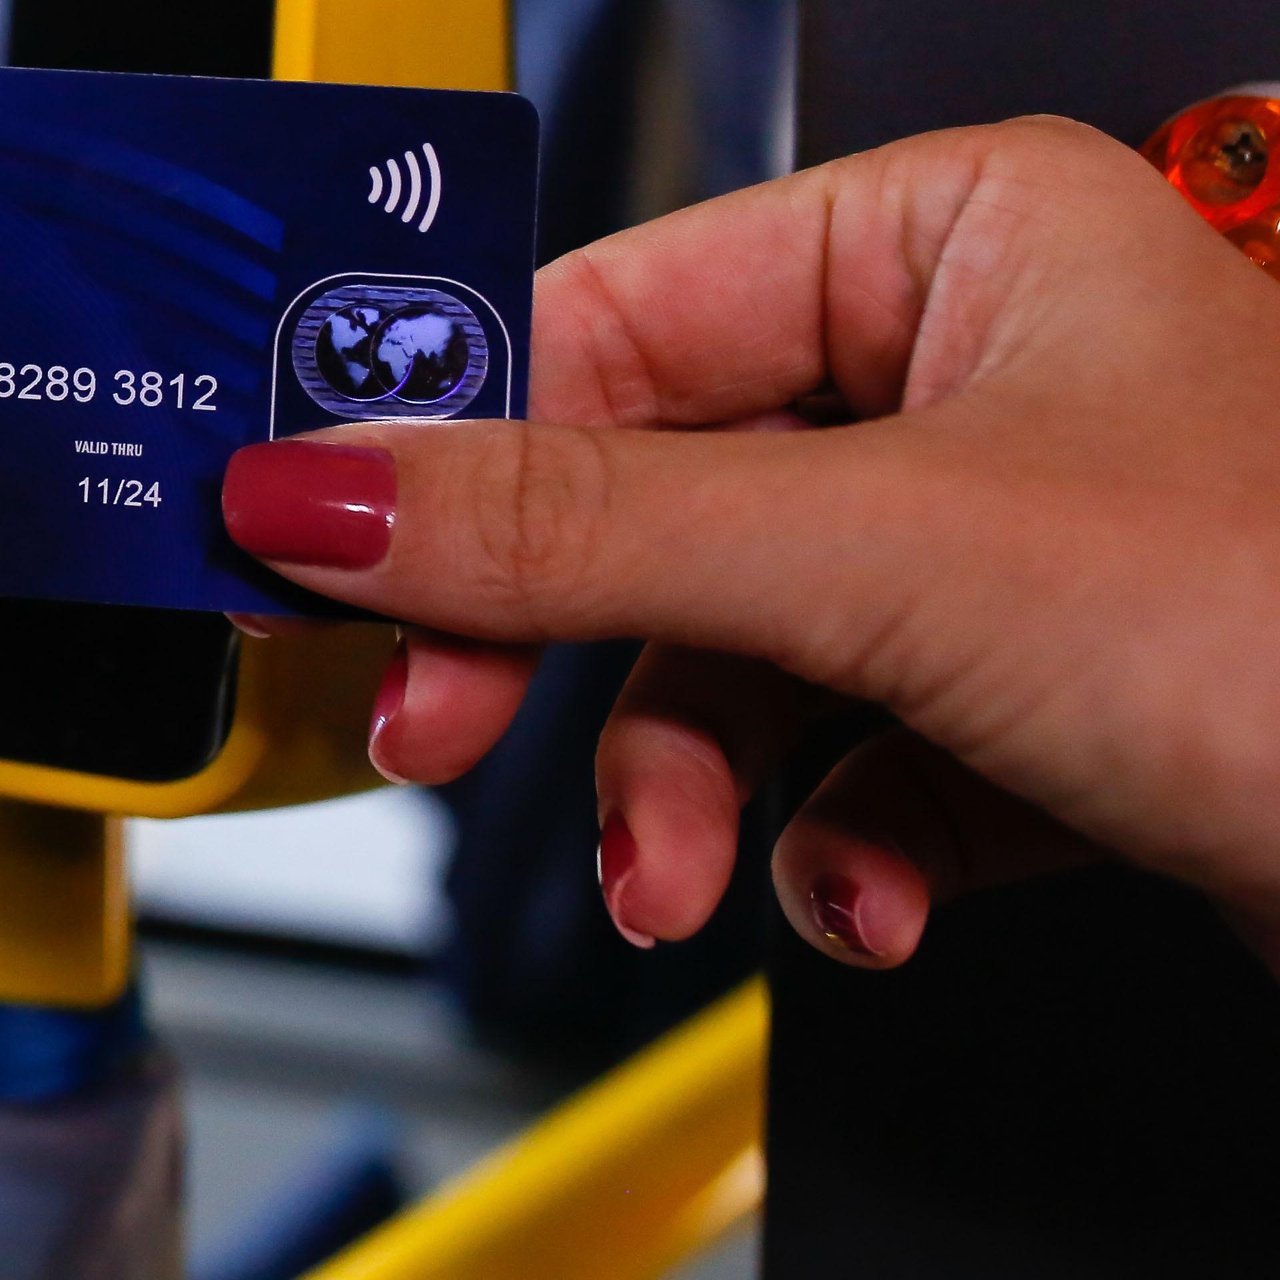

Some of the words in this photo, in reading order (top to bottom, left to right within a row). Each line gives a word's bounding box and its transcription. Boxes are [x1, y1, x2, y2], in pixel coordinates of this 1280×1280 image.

[111, 368, 219, 412] 3812
[74, 439, 109, 456] VALID
[111, 441, 143, 458] THRU
[76, 476, 163, 509] 11/24
